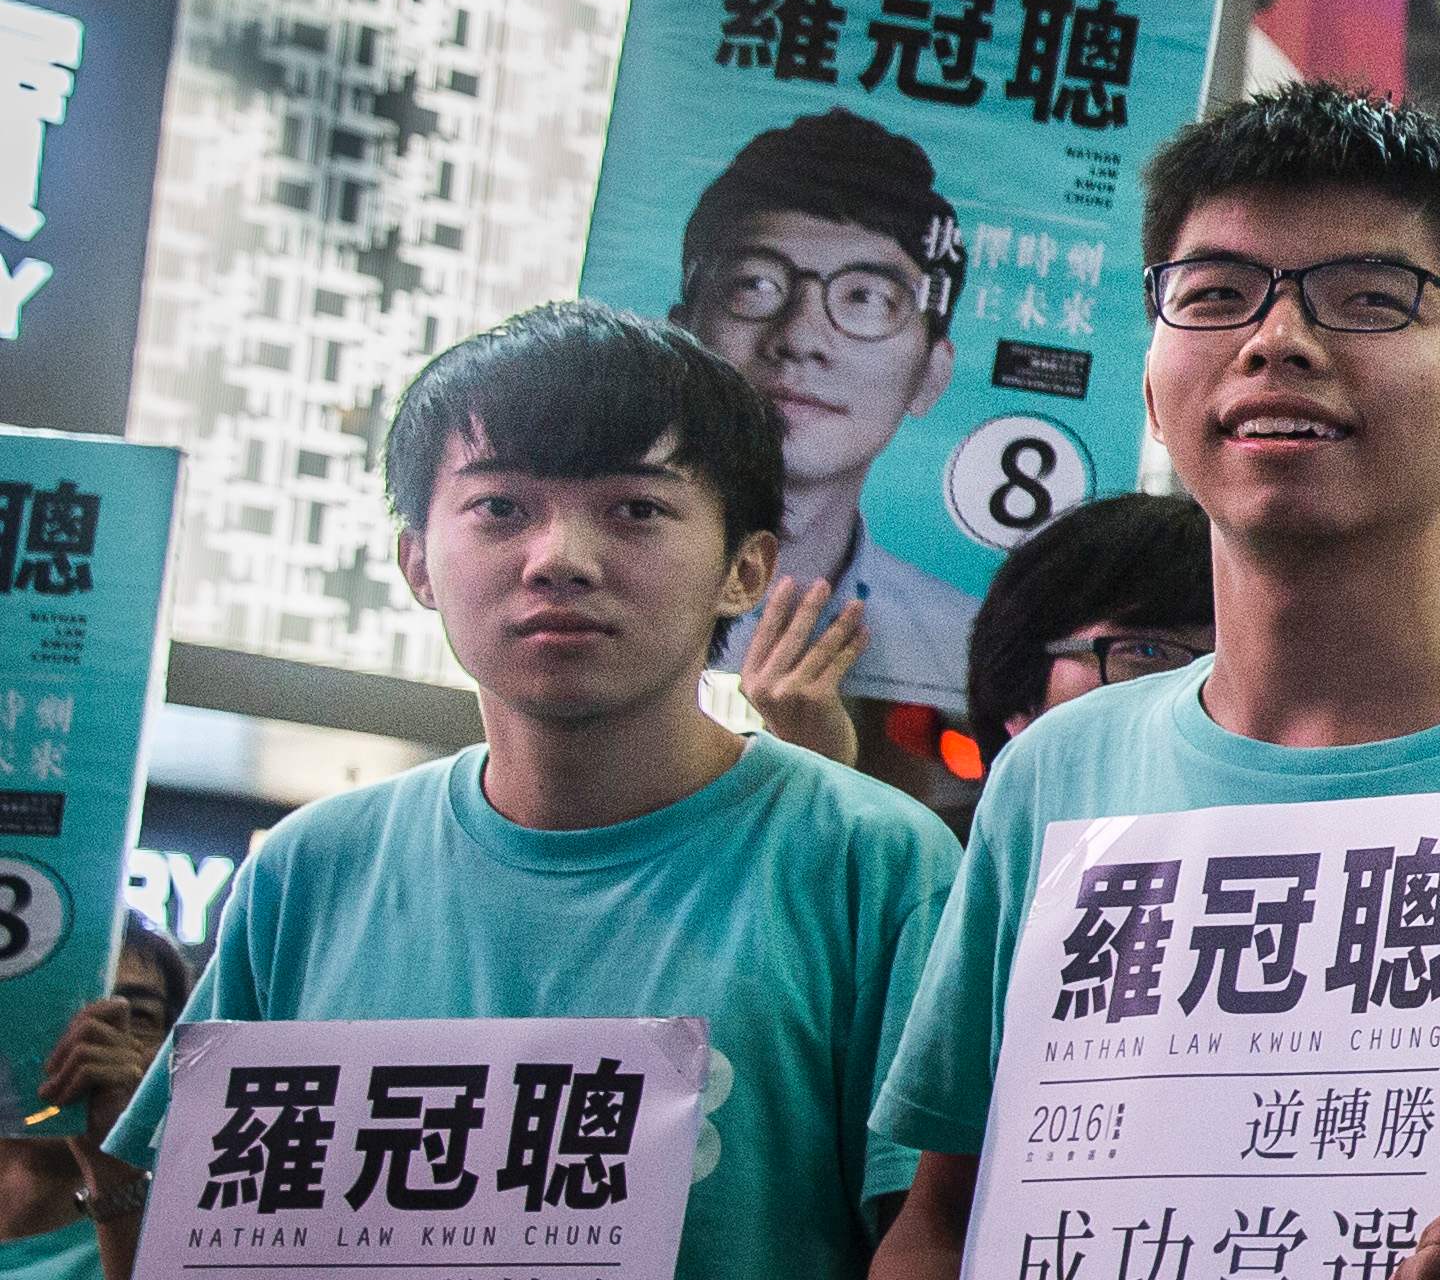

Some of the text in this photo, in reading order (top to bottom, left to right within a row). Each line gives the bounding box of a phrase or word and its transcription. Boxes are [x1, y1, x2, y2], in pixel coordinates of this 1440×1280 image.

[989, 437, 1056, 530] 8
[1045, 1036, 1145, 1062] NATHAN
[1169, 1033, 1223, 1056] LAW
[1250, 1030, 1322, 1053] KWUN
[198, 1059, 645, 1215] 羅冠聰
[1029, 1103, 1103, 1143] 2016
[1241, 1086, 1435, 1160] 逆轉勝
[188, 1225, 623, 1248] NATHAN LAW KWUN CHUNG
